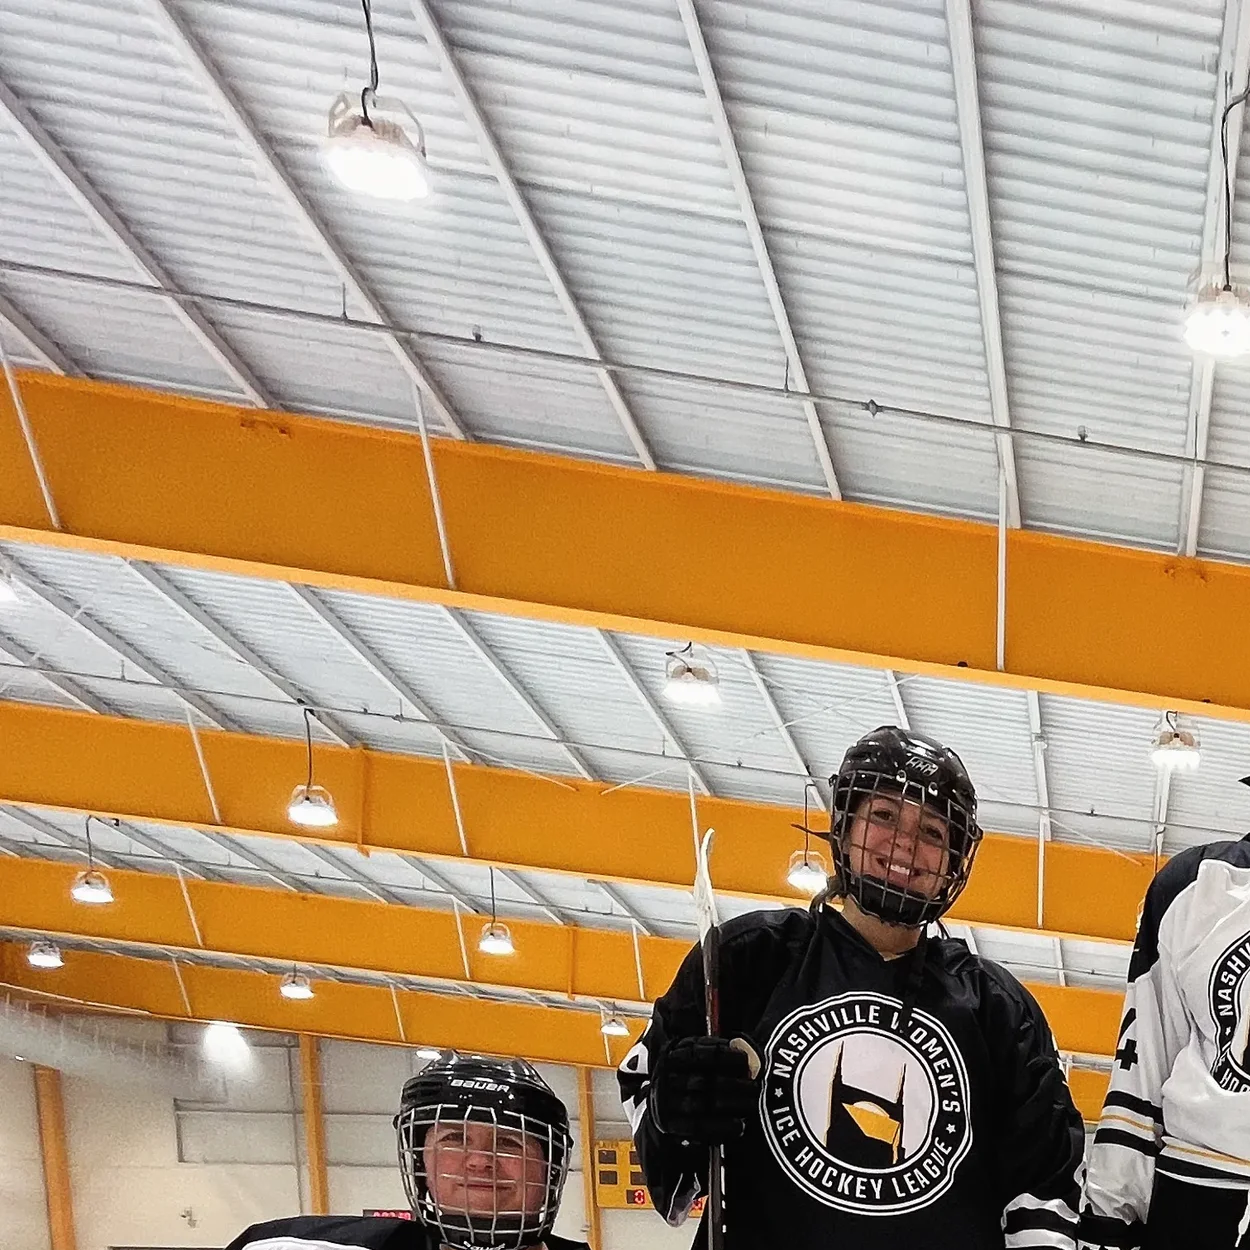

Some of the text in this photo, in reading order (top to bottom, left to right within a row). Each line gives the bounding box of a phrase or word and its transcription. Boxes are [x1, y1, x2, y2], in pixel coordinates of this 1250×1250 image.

[450, 1079, 510, 1093] BAUER
[773, 1004, 961, 1114] NASHVILLE WOMEN'S
[772, 1106, 801, 1148] ICE
[794, 1146, 885, 1200] HOCKEY
